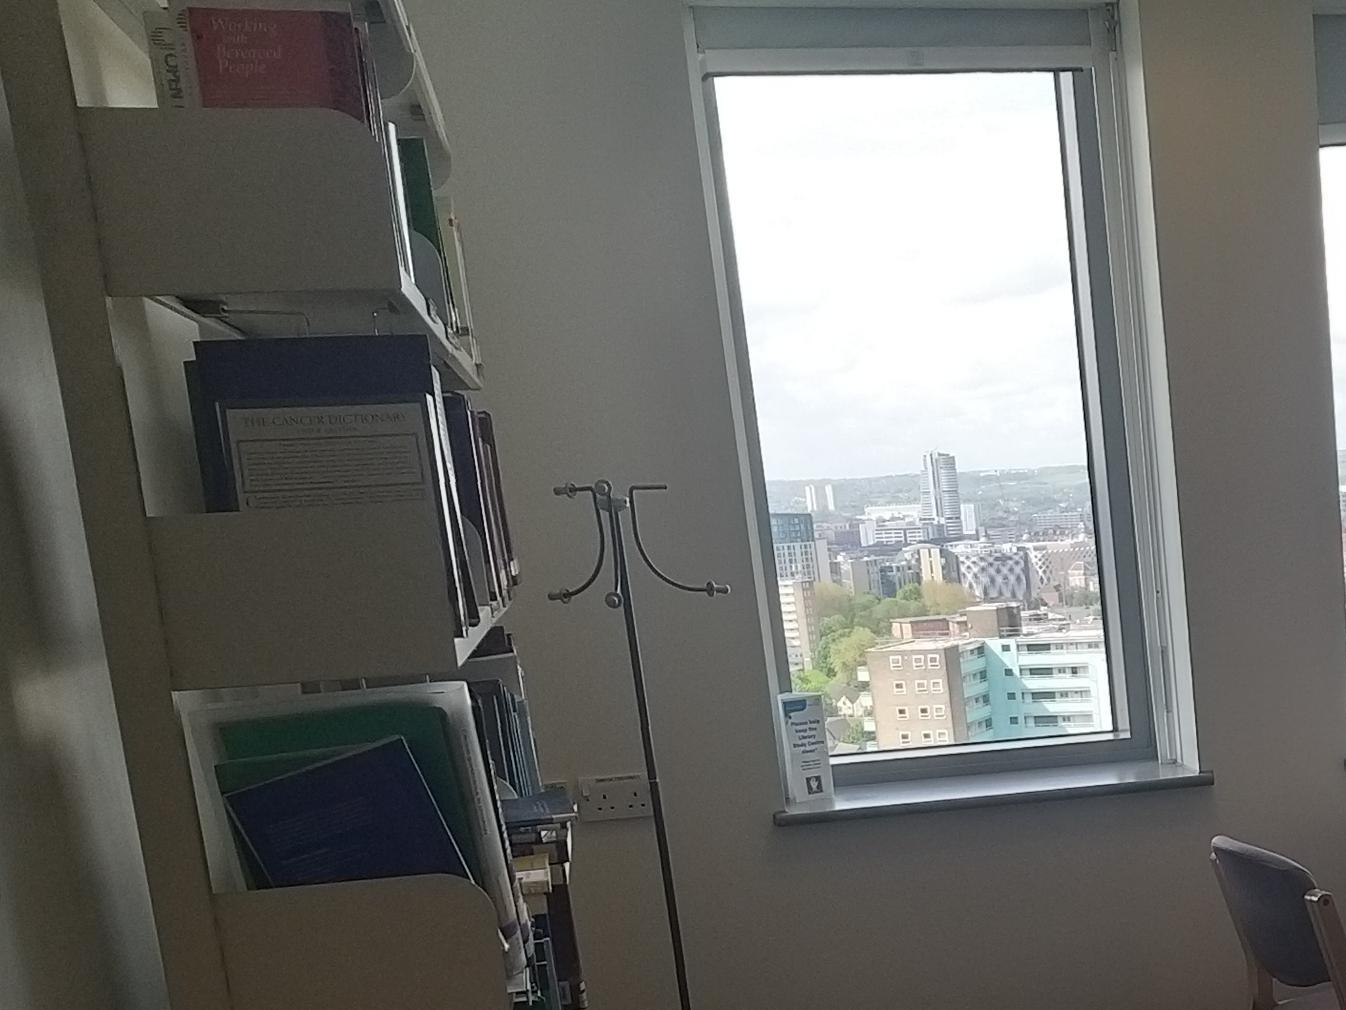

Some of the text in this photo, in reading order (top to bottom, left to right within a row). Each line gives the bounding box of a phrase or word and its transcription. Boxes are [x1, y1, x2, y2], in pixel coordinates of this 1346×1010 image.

[209, 15, 278, 36] Working
[218, 59, 268, 77] People
[271, 414, 326, 426] CANCER
[328, 411, 407, 425] DICTIONARY
